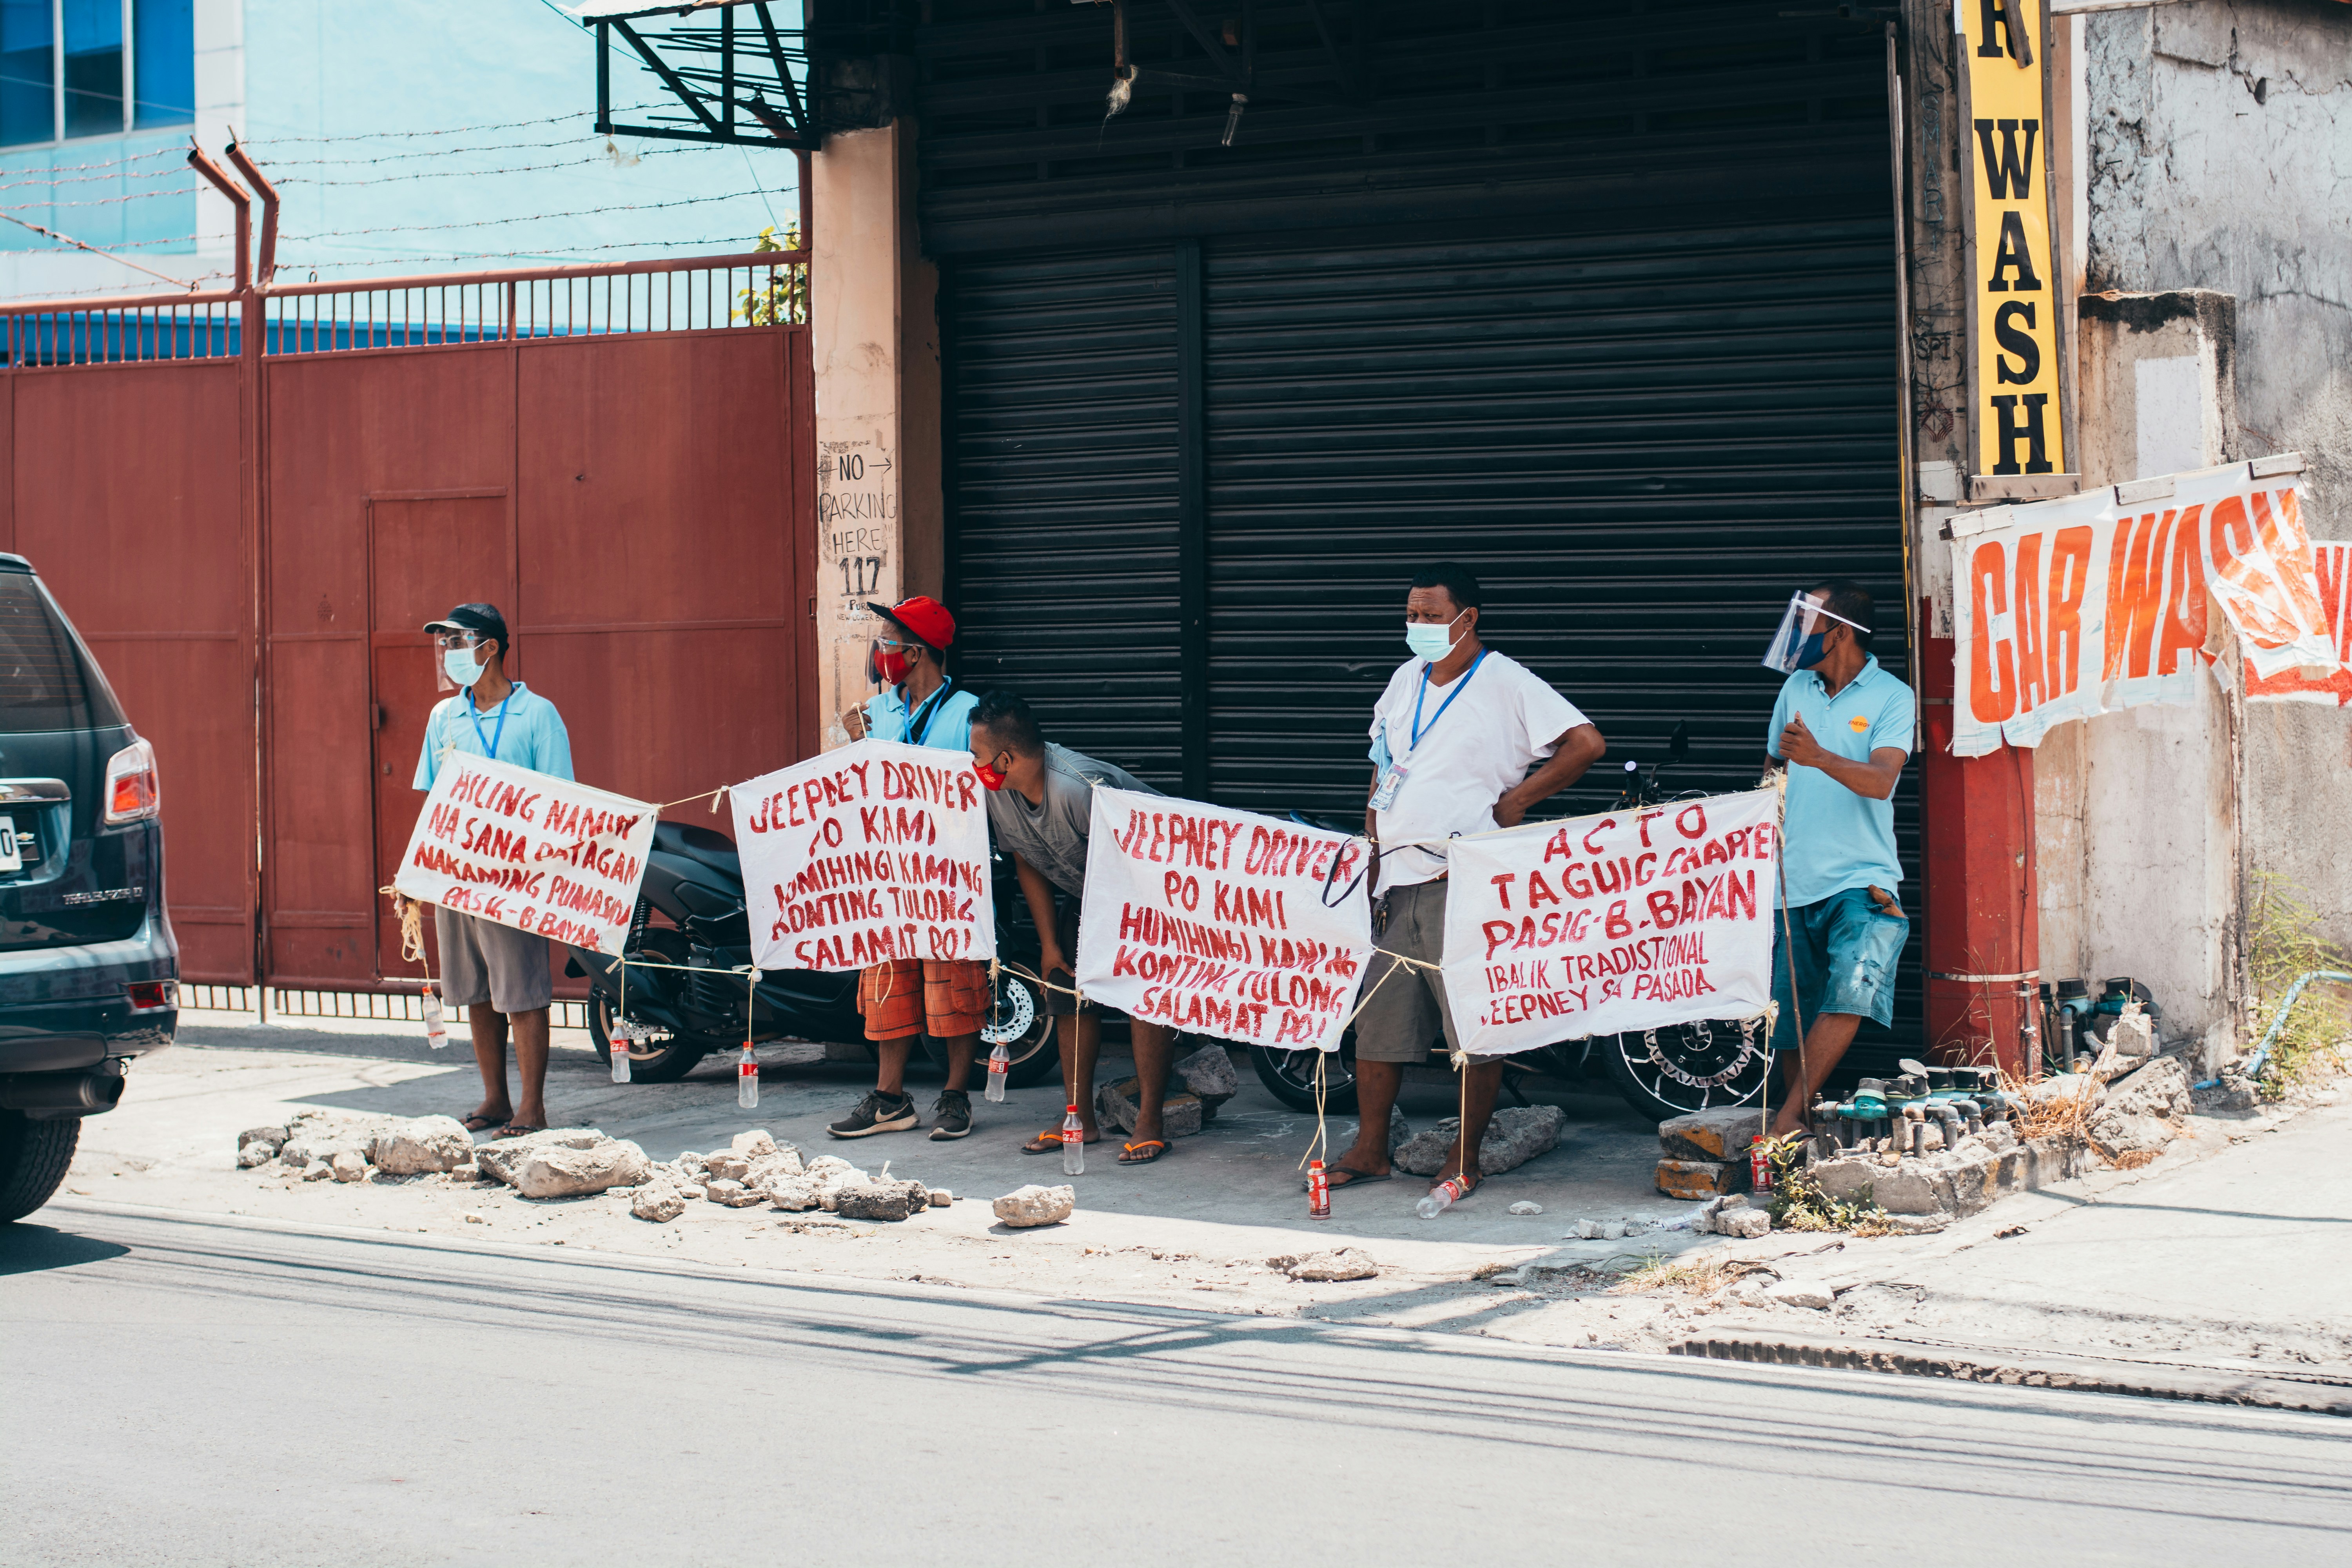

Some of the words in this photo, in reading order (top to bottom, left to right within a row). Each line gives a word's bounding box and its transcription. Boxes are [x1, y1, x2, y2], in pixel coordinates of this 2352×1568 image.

[1974, 119, 2053, 475] WASH
[840, 454, 863, 481] NO
[819, 492, 897, 522] PARKING
[839, 557, 880, 597] 117
[1970, 525, 2093, 724] CAR
[450, 766, 541, 822] HILING
[750, 760, 870, 833] JEEPNEY
[881, 760, 977, 812] DRIVER
[860, 805, 936, 846] KAMI
[1114, 808, 1243, 871] JEEPNEY
[1244, 825, 1361, 884] DRIVER
[1491, 852, 1657, 912] TAGUIG
[1661, 822, 1777, 878] CHAPTE
[887, 886, 975, 923] TULONG
[1164, 870, 1199, 913] PO
[1214, 879, 1287, 930] KAMI
[795, 923, 918, 970] SALAMAT
[1485, 958, 1552, 994] IBALIK
[1561, 931, 1710, 984] TRADISTIONAL
[1113, 944, 1240, 994] KONTING
[1238, 969, 1347, 1020] TULONG
[1632, 967, 1717, 1003] PASADA
[1132, 985, 1269, 1038] SALAMAT
